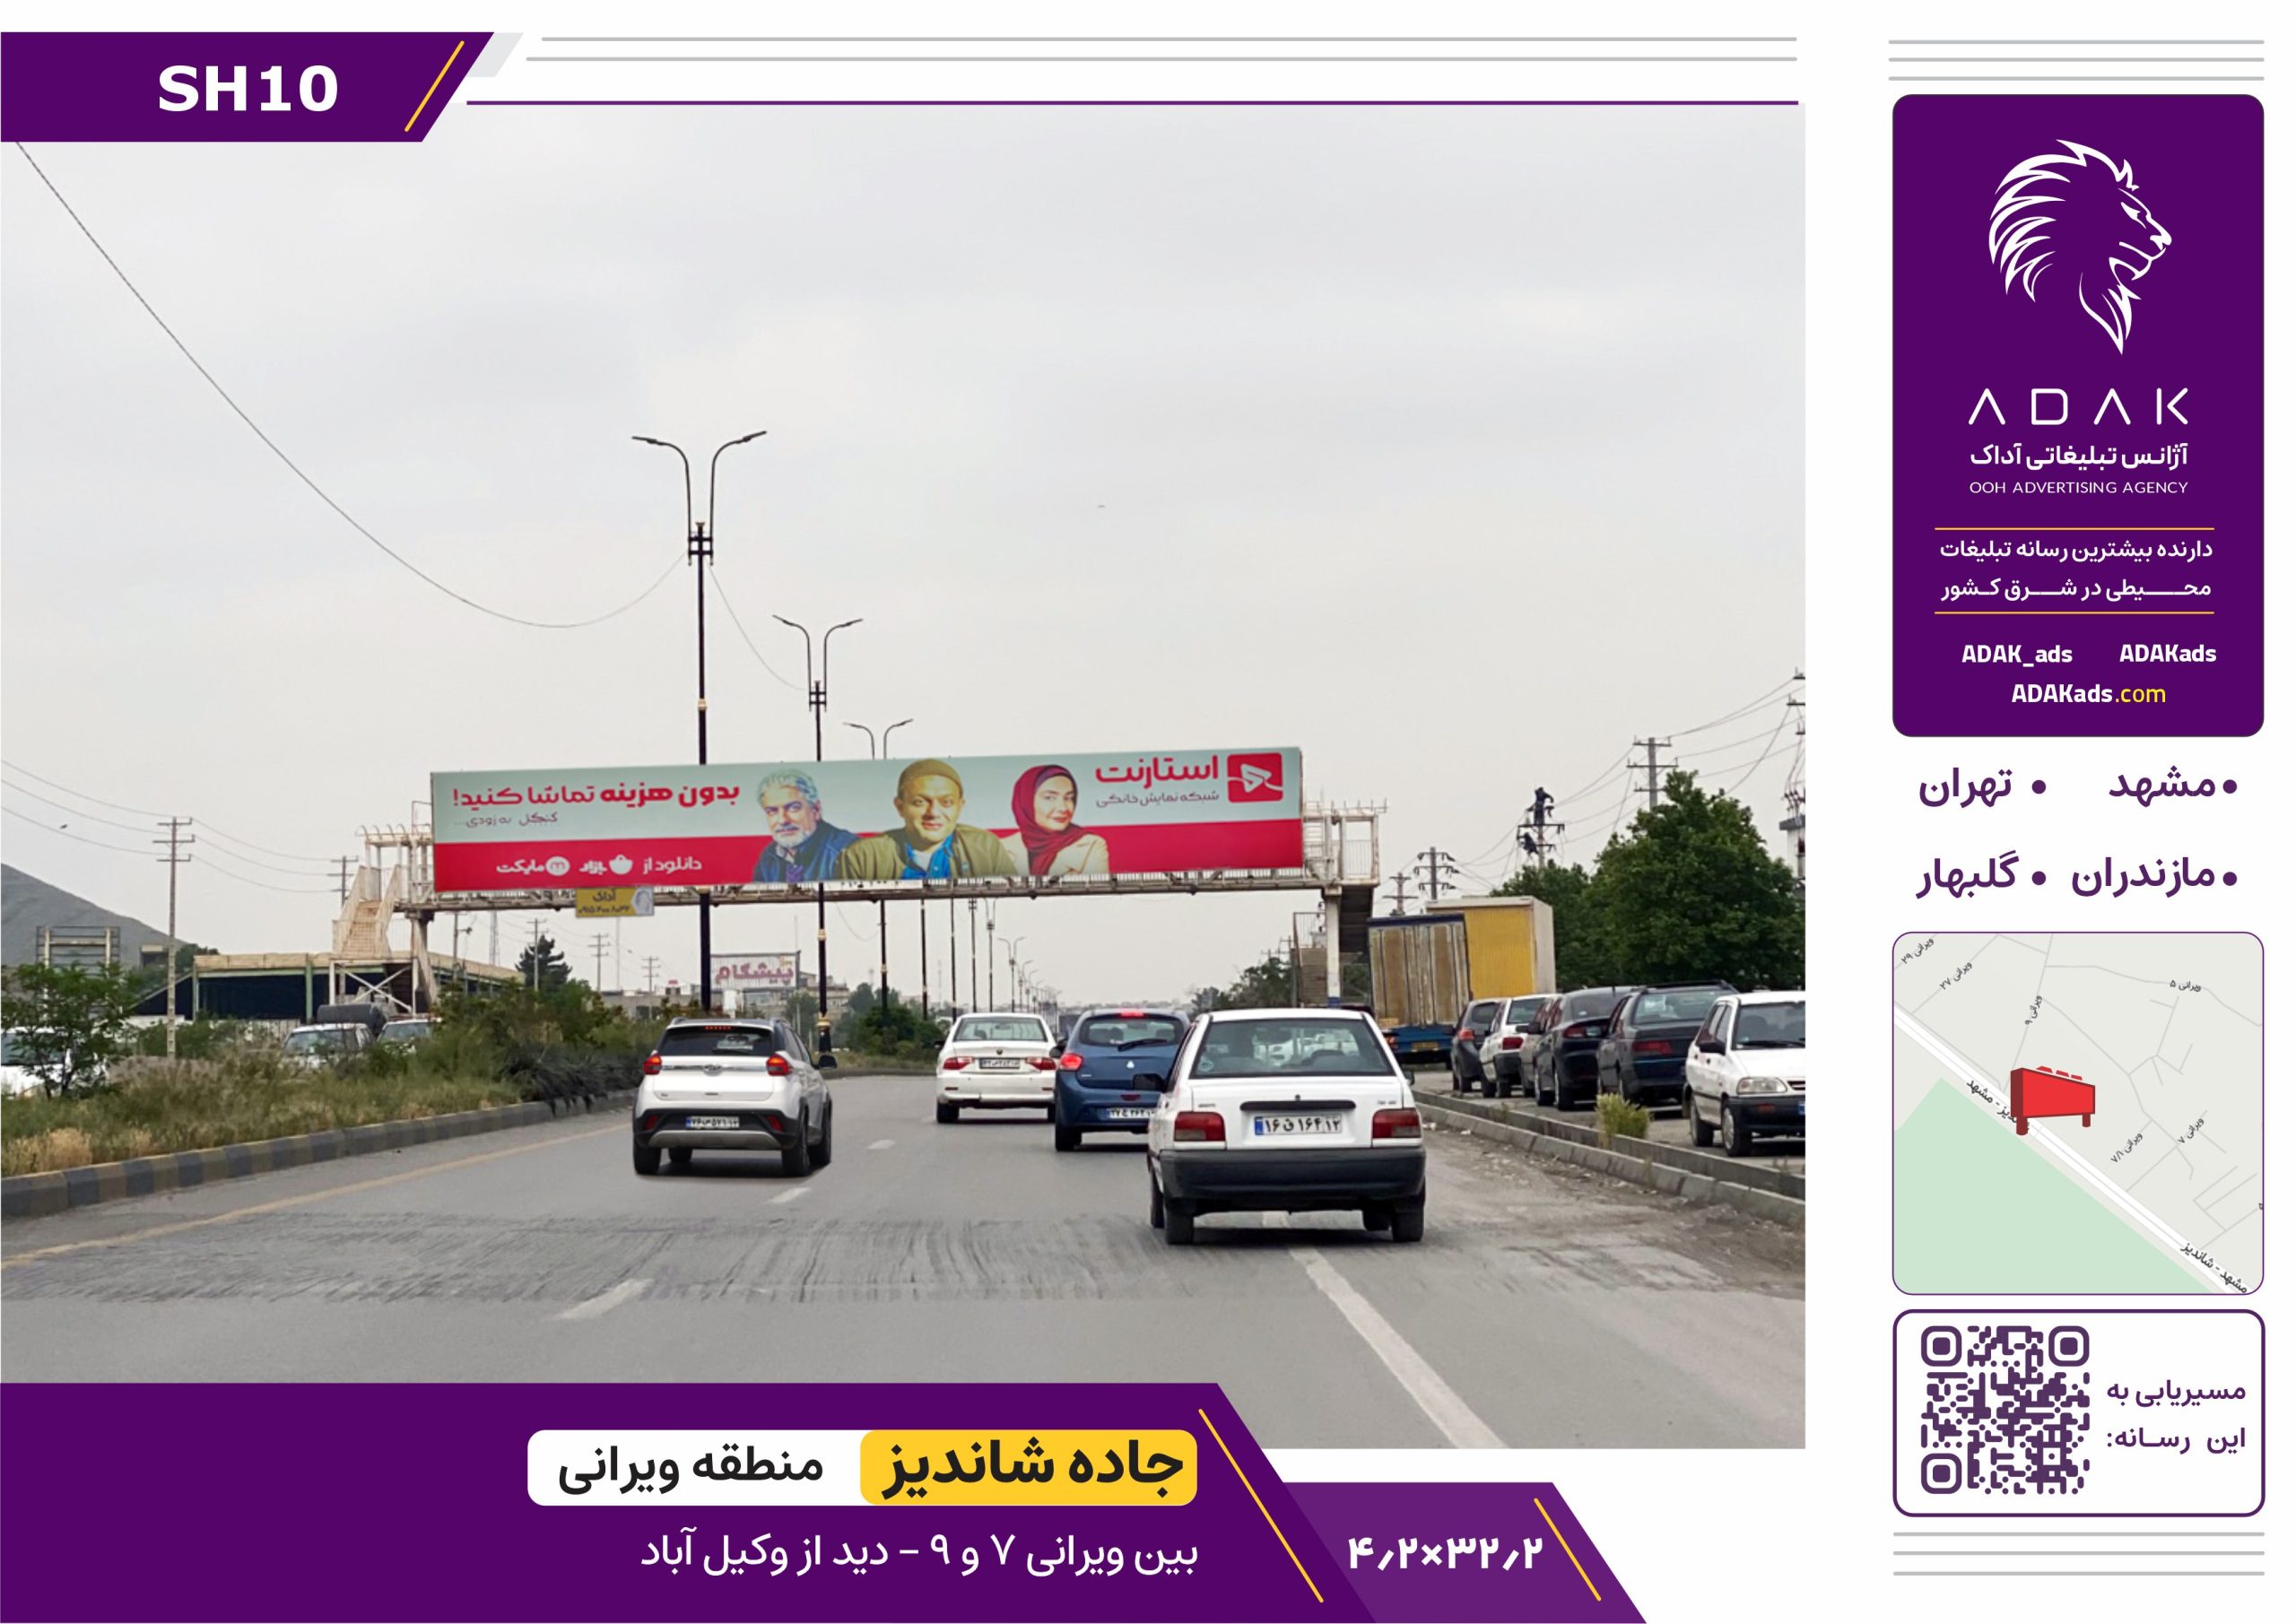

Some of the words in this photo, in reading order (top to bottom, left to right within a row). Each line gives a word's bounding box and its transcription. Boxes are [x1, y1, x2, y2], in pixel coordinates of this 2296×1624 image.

[1095, 754, 1219, 789] استارنت
[453, 787, 523, 811] کنید!
[528, 786, 594, 803] تماشا
[600, 783, 673, 808] هزینه
[679, 786, 739, 807] بدون
[1140, 791, 1178, 806] نمایش
[1180, 790, 1220, 805] شبکه
[643, 857, 653, 875] از
[656, 856, 702, 875] دانلود
